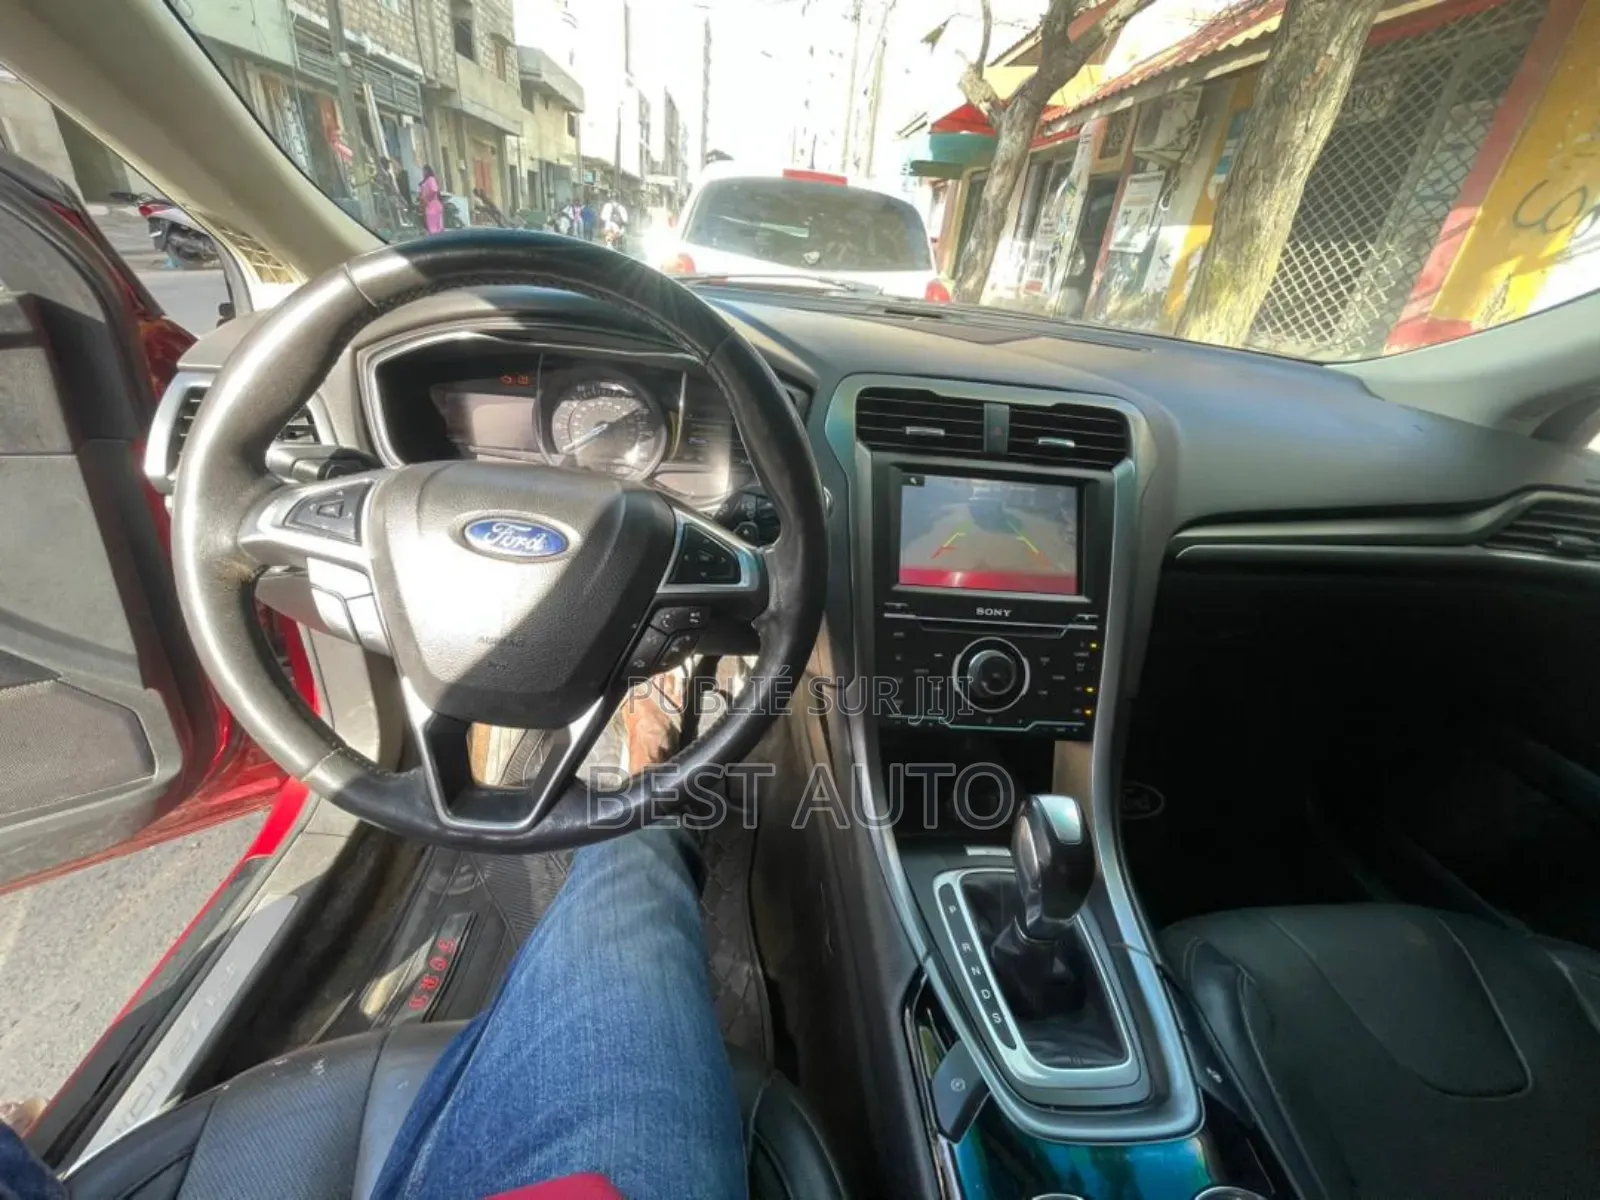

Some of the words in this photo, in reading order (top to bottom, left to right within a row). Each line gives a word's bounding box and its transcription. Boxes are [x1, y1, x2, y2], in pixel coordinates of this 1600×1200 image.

[484, 522, 549, 551] Ford
[975, 606, 1012, 617] SONY
[961, 942, 972, 952] R
[971, 965, 982, 976] N
[980, 988, 991, 1000] D
[991, 1012, 1002, 1024] S
